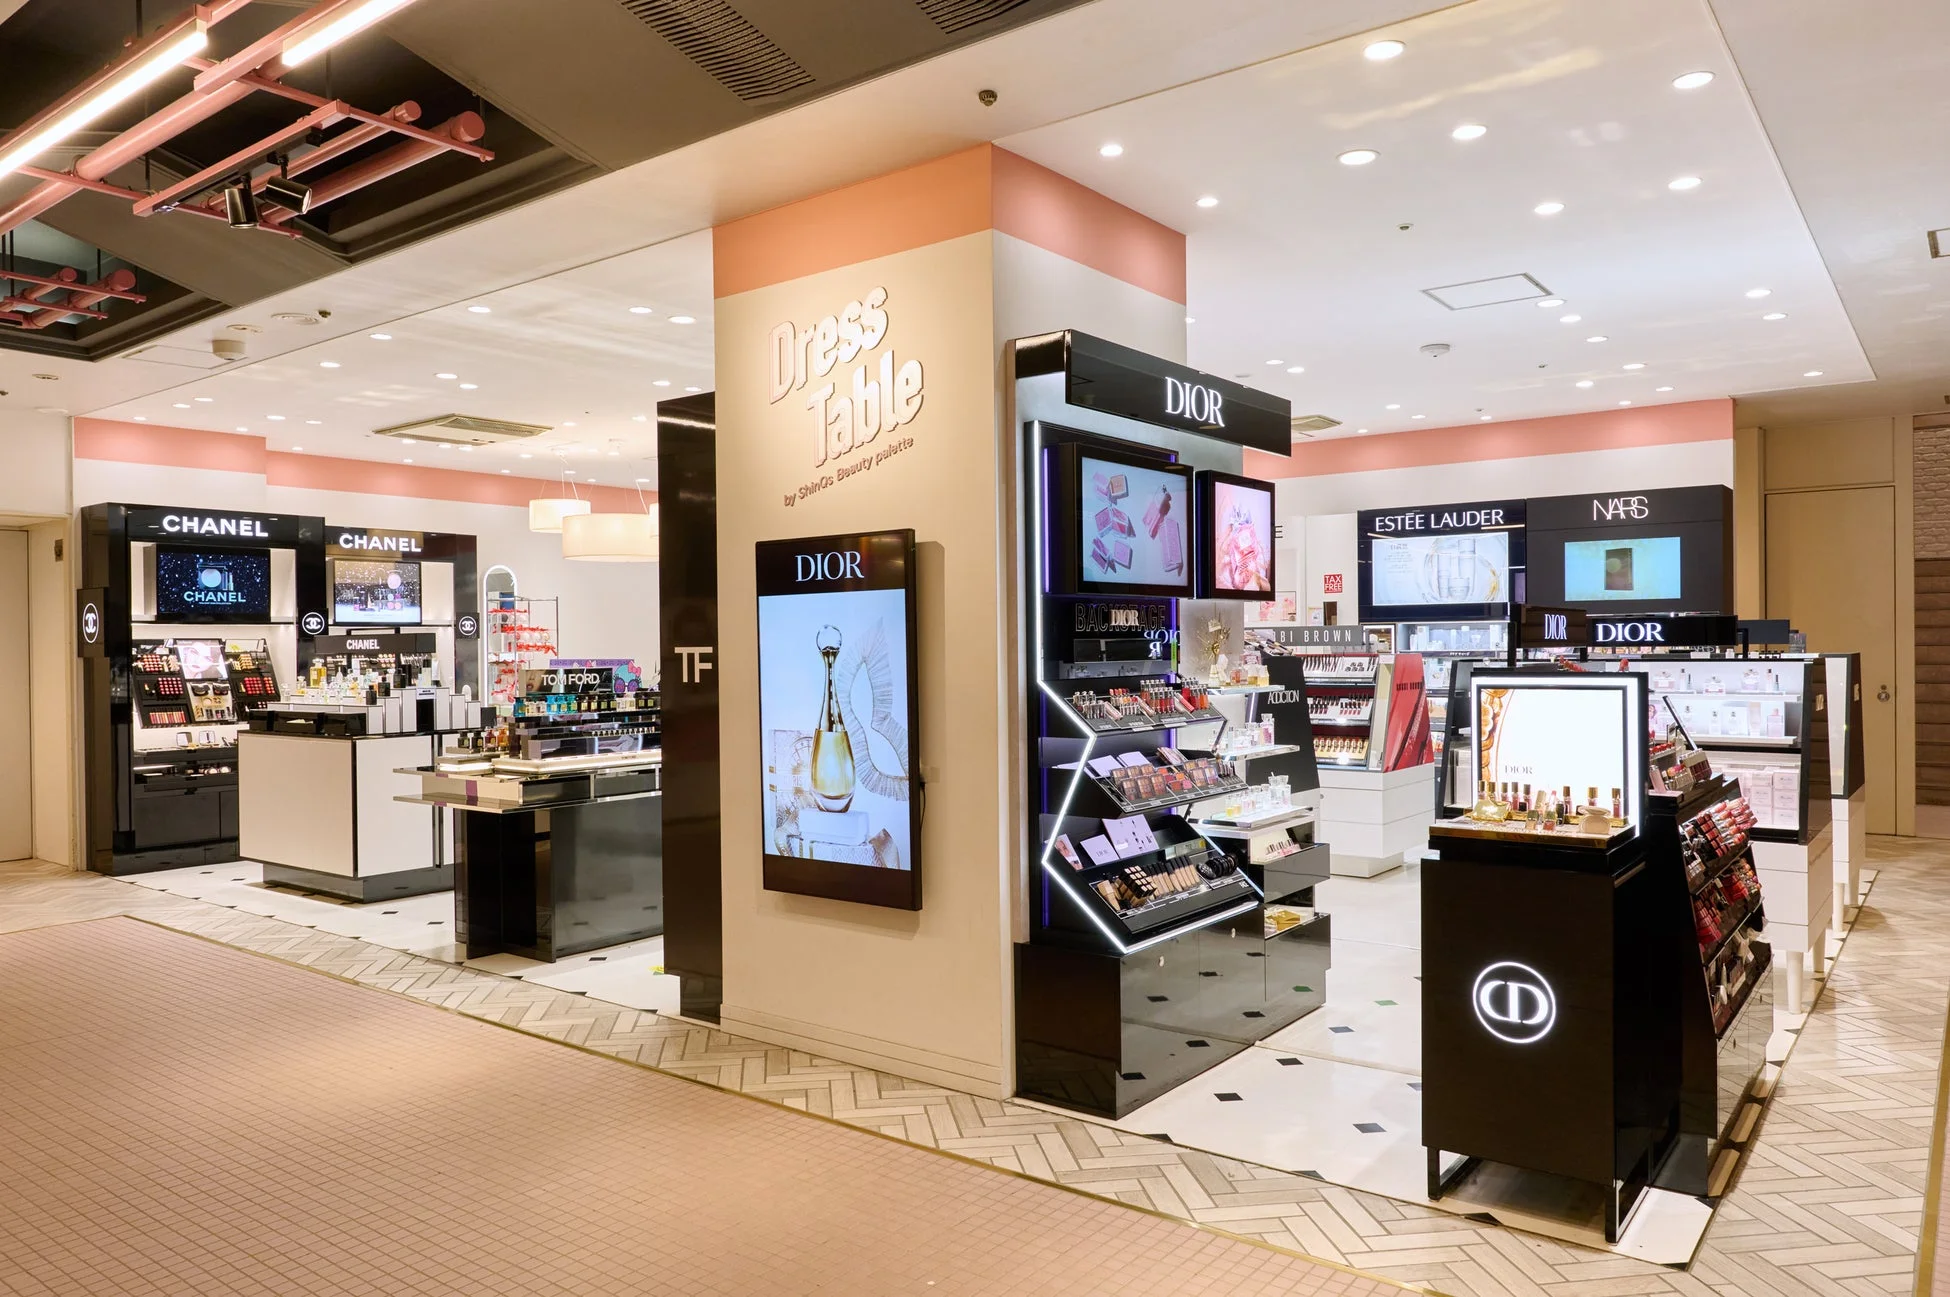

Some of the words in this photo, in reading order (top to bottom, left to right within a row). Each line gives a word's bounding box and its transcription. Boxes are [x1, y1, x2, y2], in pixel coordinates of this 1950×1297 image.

[769, 286, 888, 404] Dress
[807, 350, 924, 468] Table
[1165, 376, 1225, 427] DIOR
[784, 493, 797, 507] by
[798, 476, 834, 500] ShinQs
[836, 456, 873, 481] Beauty
[875, 437, 914, 466] palette
[1593, 496, 1649, 520] NARS
[162, 515, 269, 537] CHANEL
[1430, 509, 1504, 528] LAUDER
[339, 534, 421, 552] CHANEL
[795, 550, 865, 583] DIOR
[1325, 575, 1342, 583] TAX
[1325, 583, 1342, 591] FREE
[183, 591, 246, 602] CHANEL
[1110, 609, 1140, 626] DIOR
[1544, 613, 1567, 640] DIOR
[1304, 630, 1351, 642] BROWN
[1595, 622, 1664, 642] DIOR
[346, 639, 380, 650] CHANEL
[541, 674, 566, 686] TOM
[568, 673, 599, 685] FORD
[1505, 765, 1533, 774] DIOR
